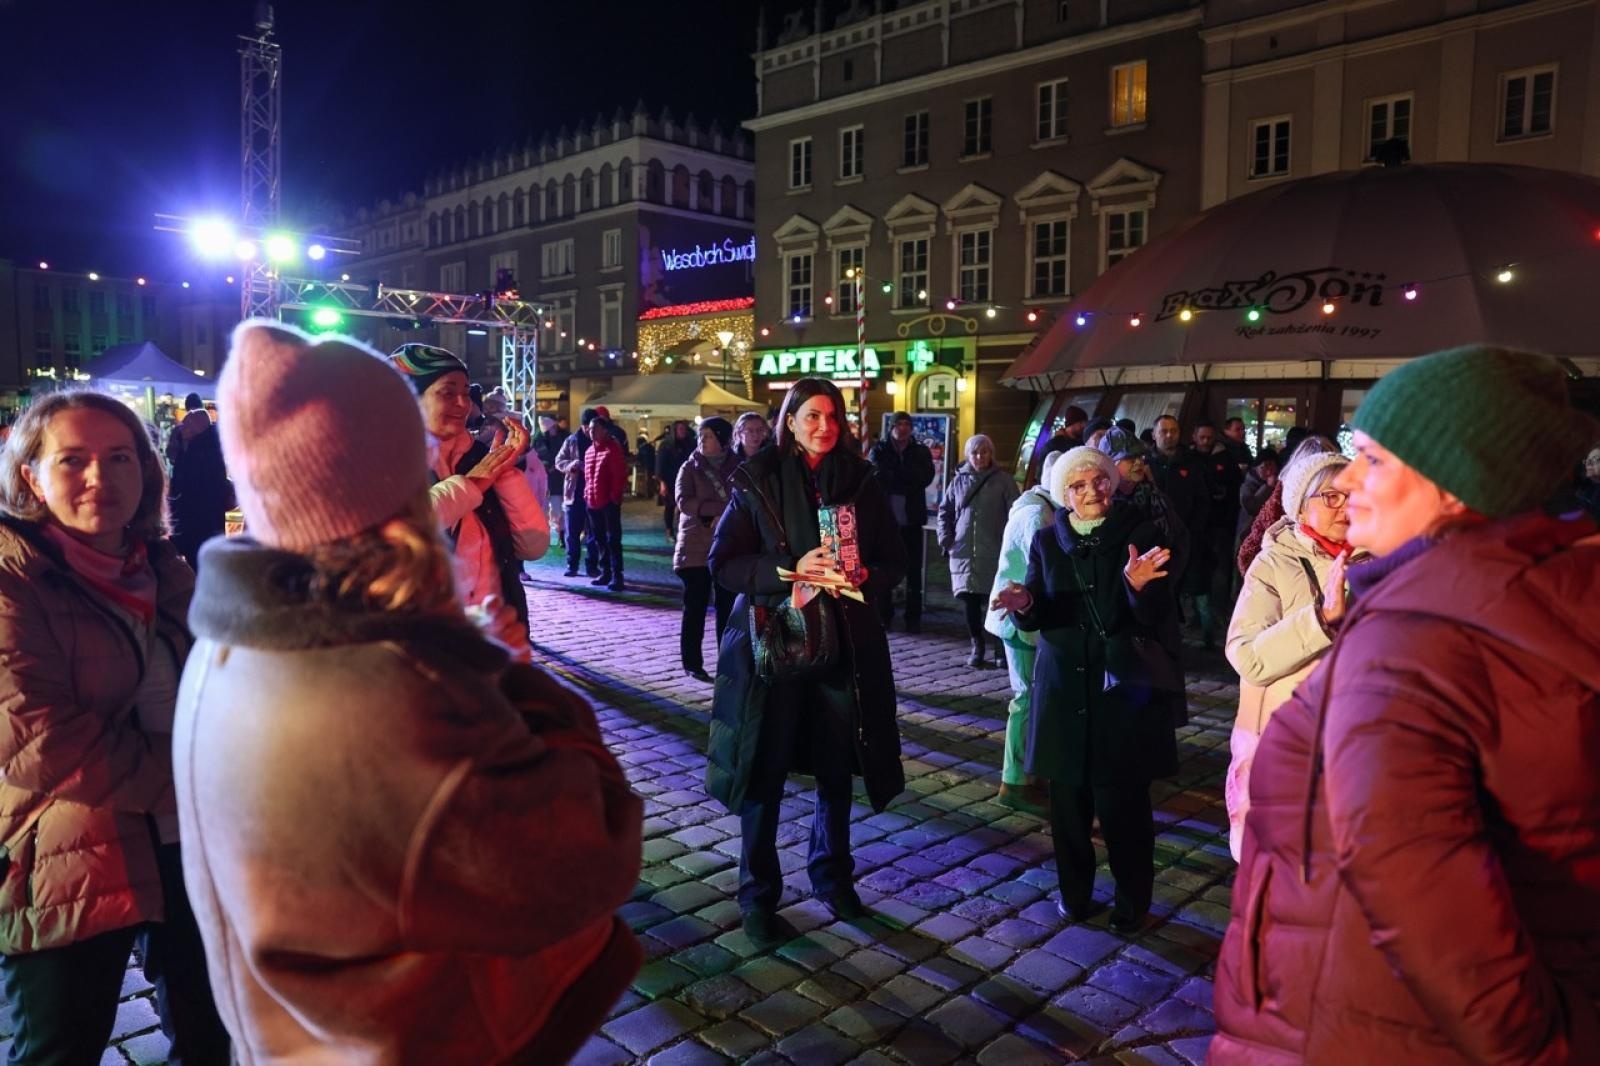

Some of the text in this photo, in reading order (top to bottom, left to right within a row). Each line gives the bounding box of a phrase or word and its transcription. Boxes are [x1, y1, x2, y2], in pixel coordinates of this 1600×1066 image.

[1235, 322, 1382, 339] Rok założenia 1997
[758, 348, 881, 375] APTEKA
